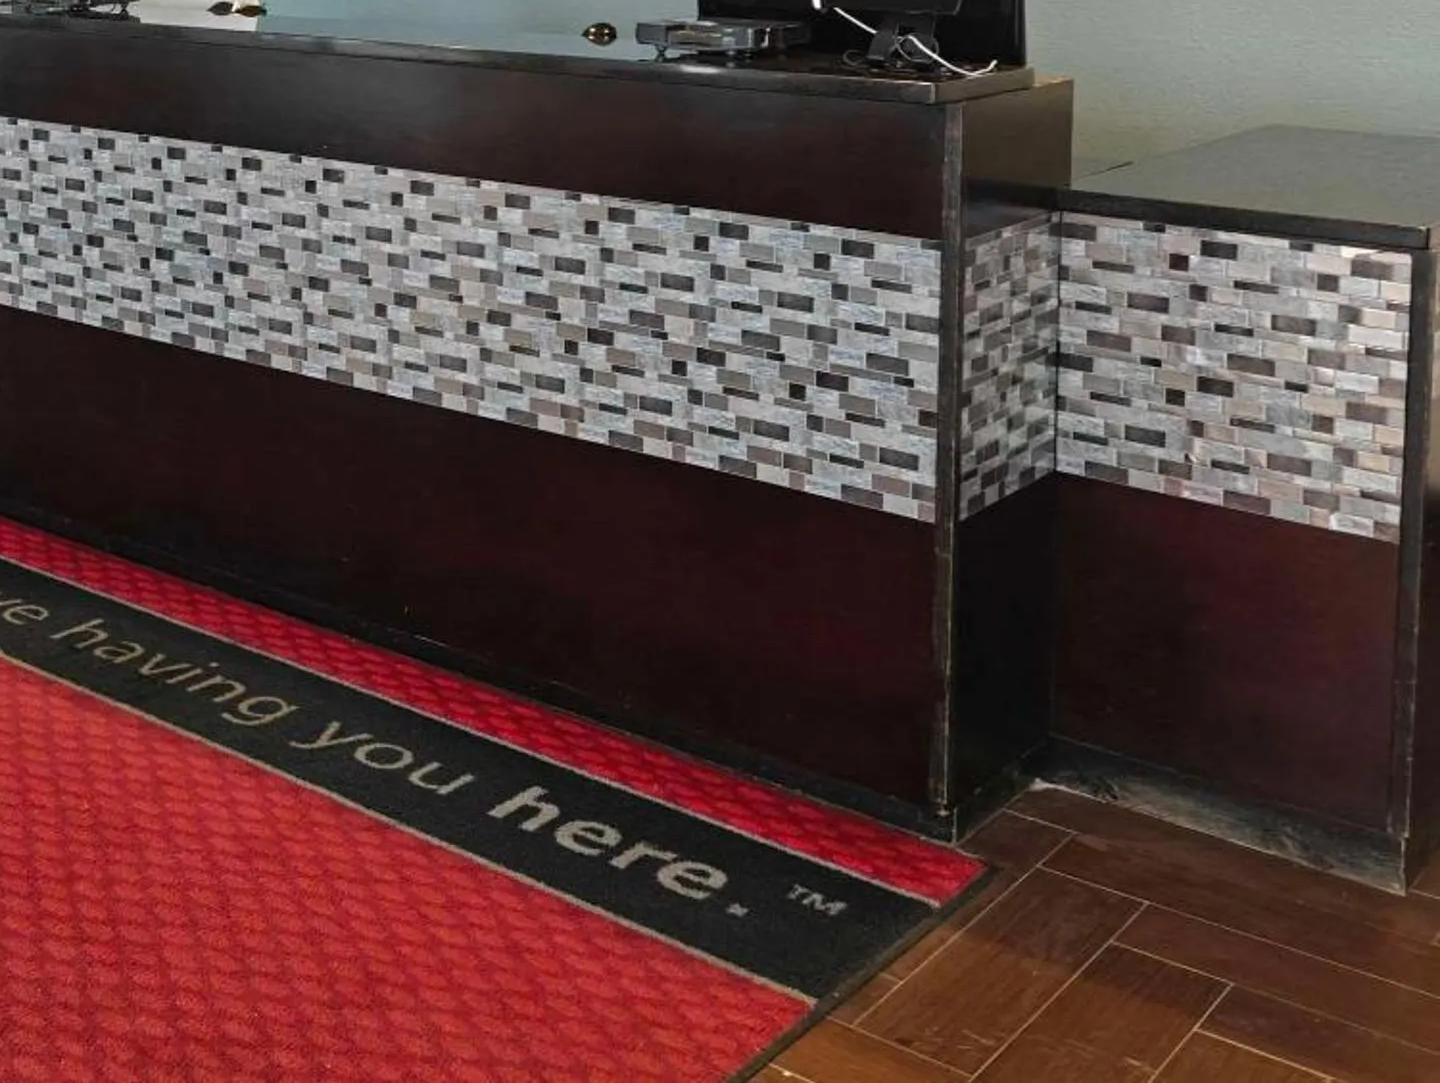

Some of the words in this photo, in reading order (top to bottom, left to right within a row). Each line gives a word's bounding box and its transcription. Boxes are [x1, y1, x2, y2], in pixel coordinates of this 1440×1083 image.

[51, 618, 297, 726] having
[289, 721, 475, 796] you
[486, 785, 749, 918] here.
